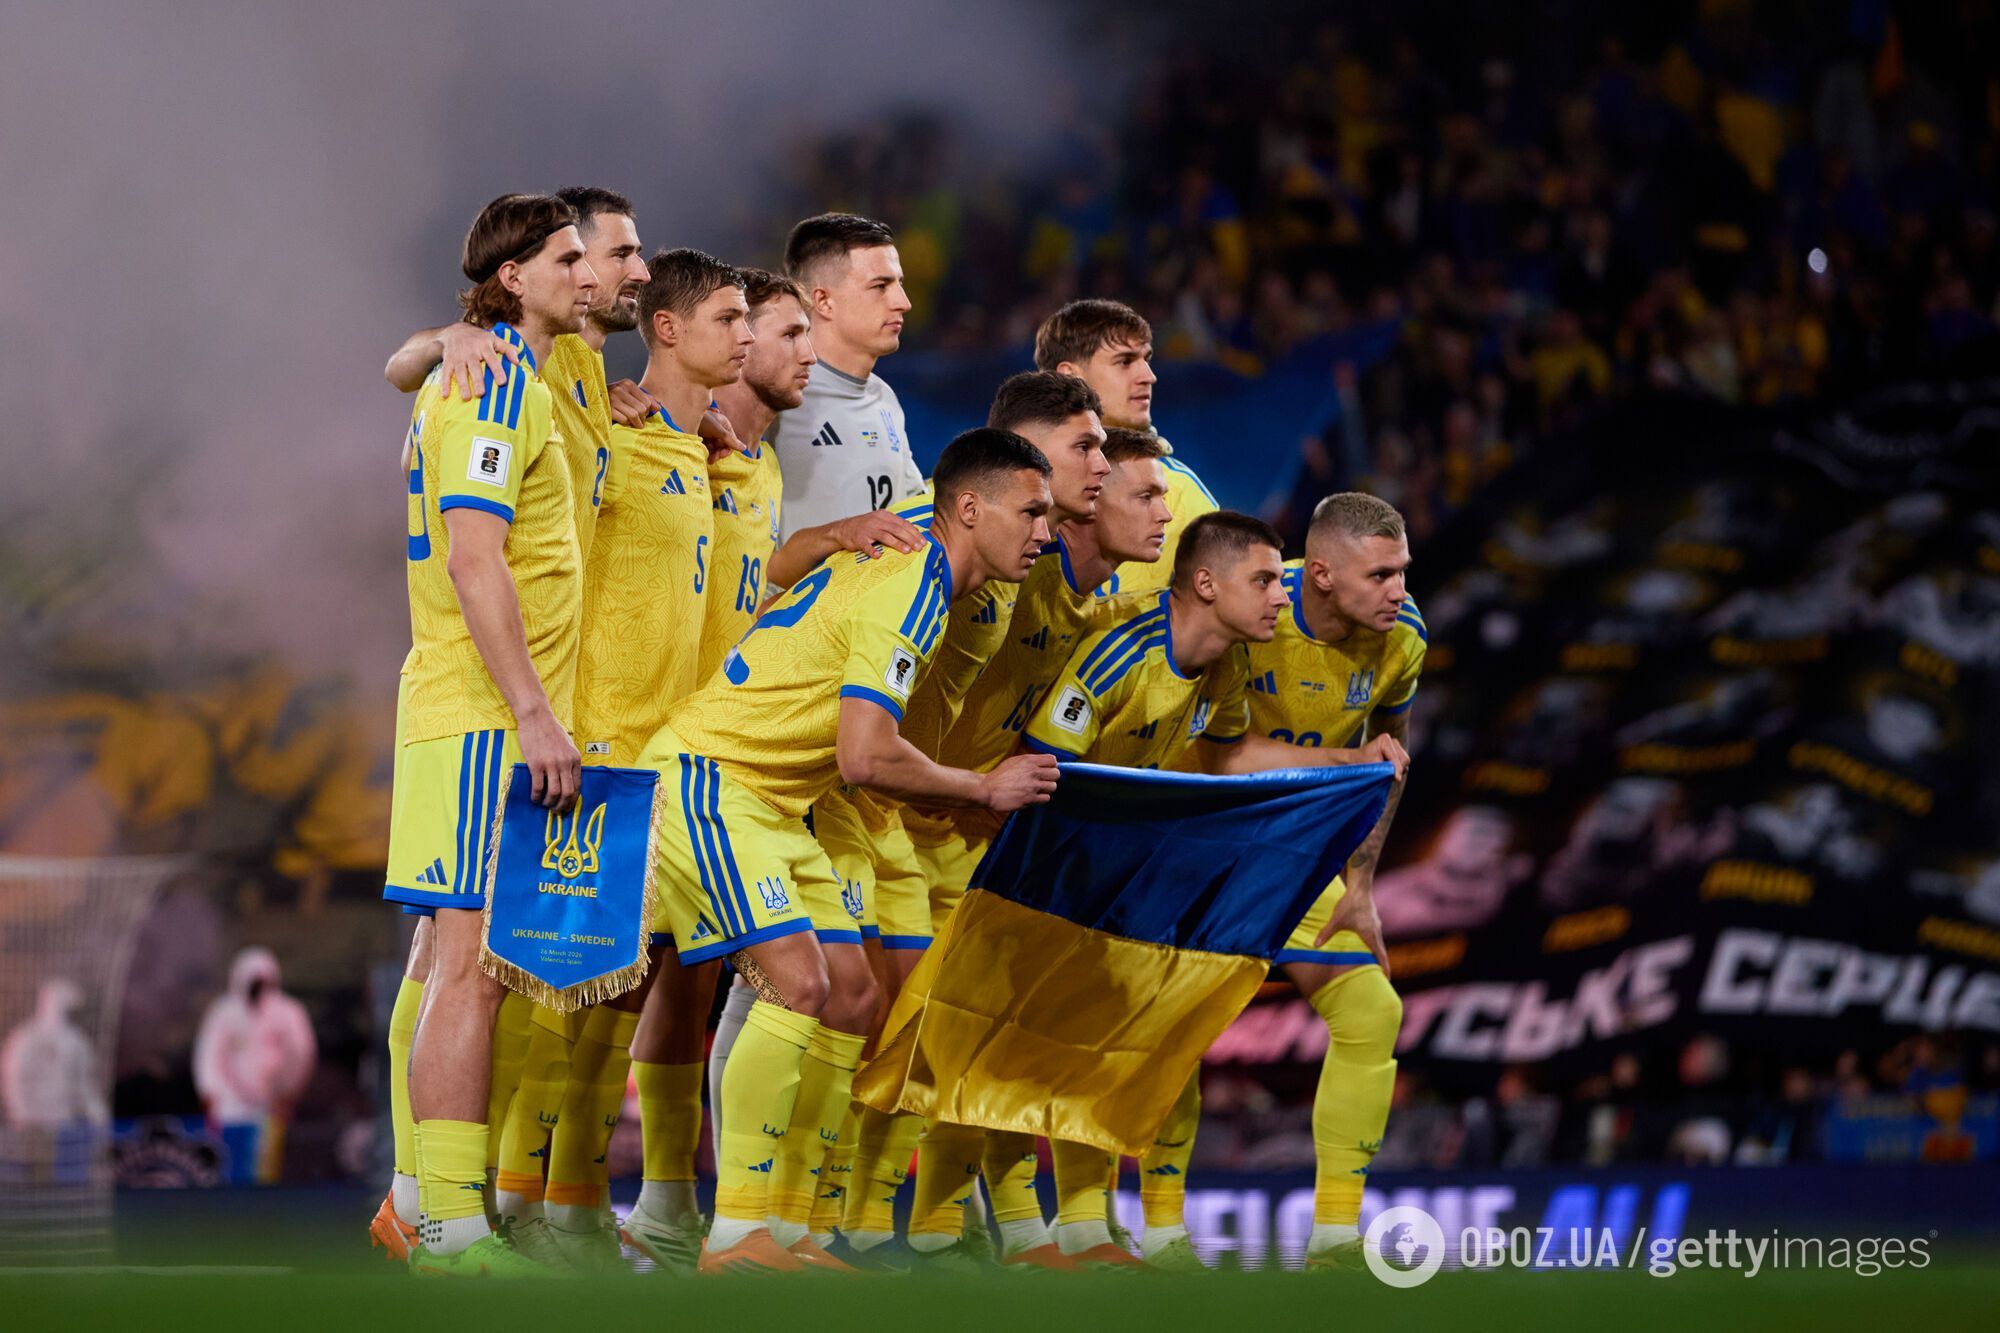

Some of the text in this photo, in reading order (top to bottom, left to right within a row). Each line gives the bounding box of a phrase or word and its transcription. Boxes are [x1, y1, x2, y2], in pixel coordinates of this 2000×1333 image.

[592, 447, 612, 507] 2
[866, 475, 893, 511] 12
[694, 535, 708, 594] 5
[735, 553, 761, 615] 19
[538, 881, 598, 898] UKRAINE
[512, 928, 559, 941] UKRAINE
[569, 933, 615, 946] SWEDEN
[604, 1114, 617, 1126] U
